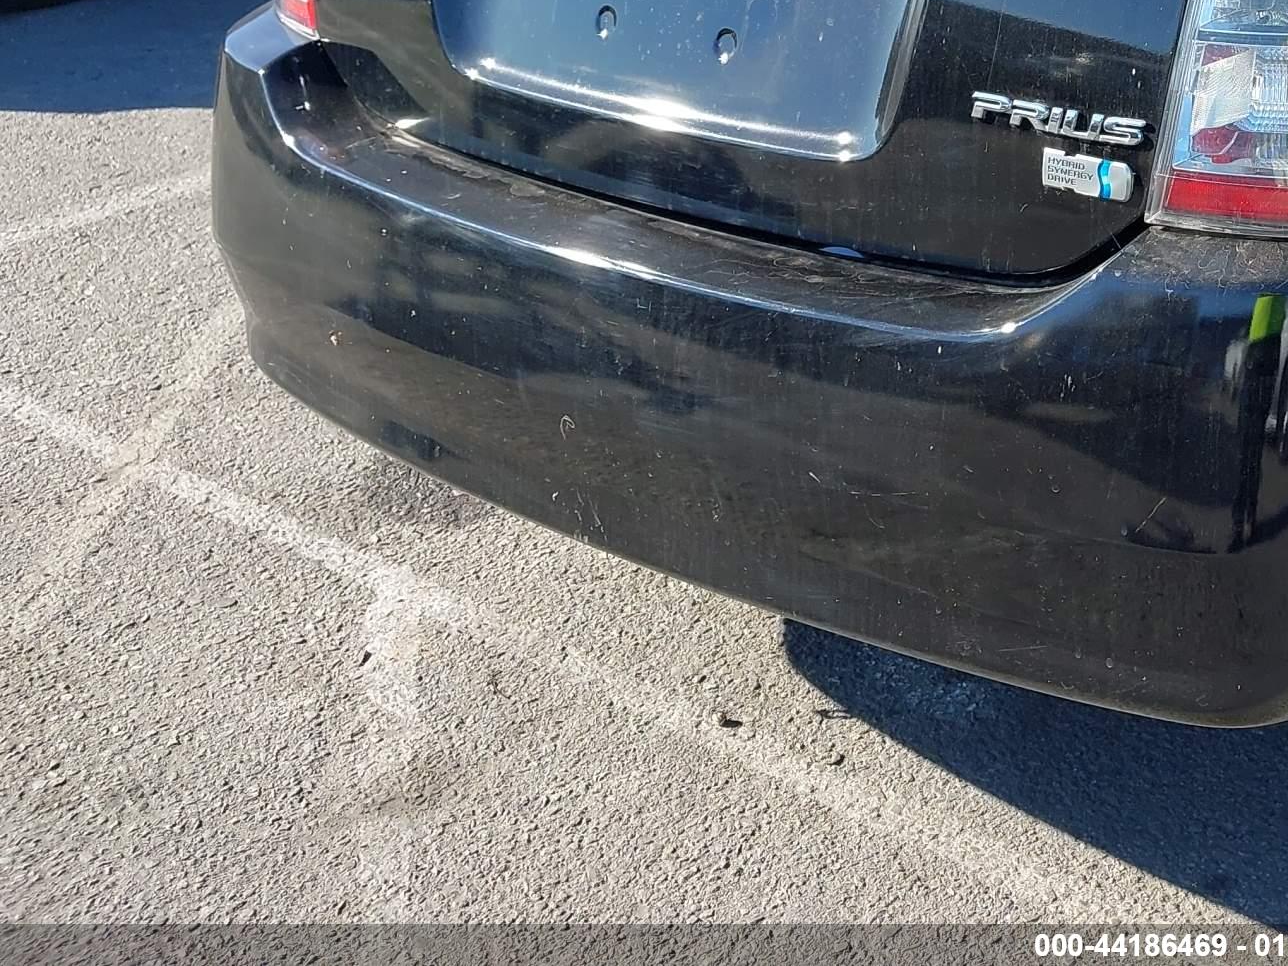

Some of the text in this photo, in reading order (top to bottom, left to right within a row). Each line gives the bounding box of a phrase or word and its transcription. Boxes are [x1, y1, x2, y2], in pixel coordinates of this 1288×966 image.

[971, 91, 1147, 145] PRIUS
[1047, 156, 1085, 171] HYBRID
[1047, 165, 1094, 181] SYNERGY
[1047, 174, 1078, 186] DRIVE
